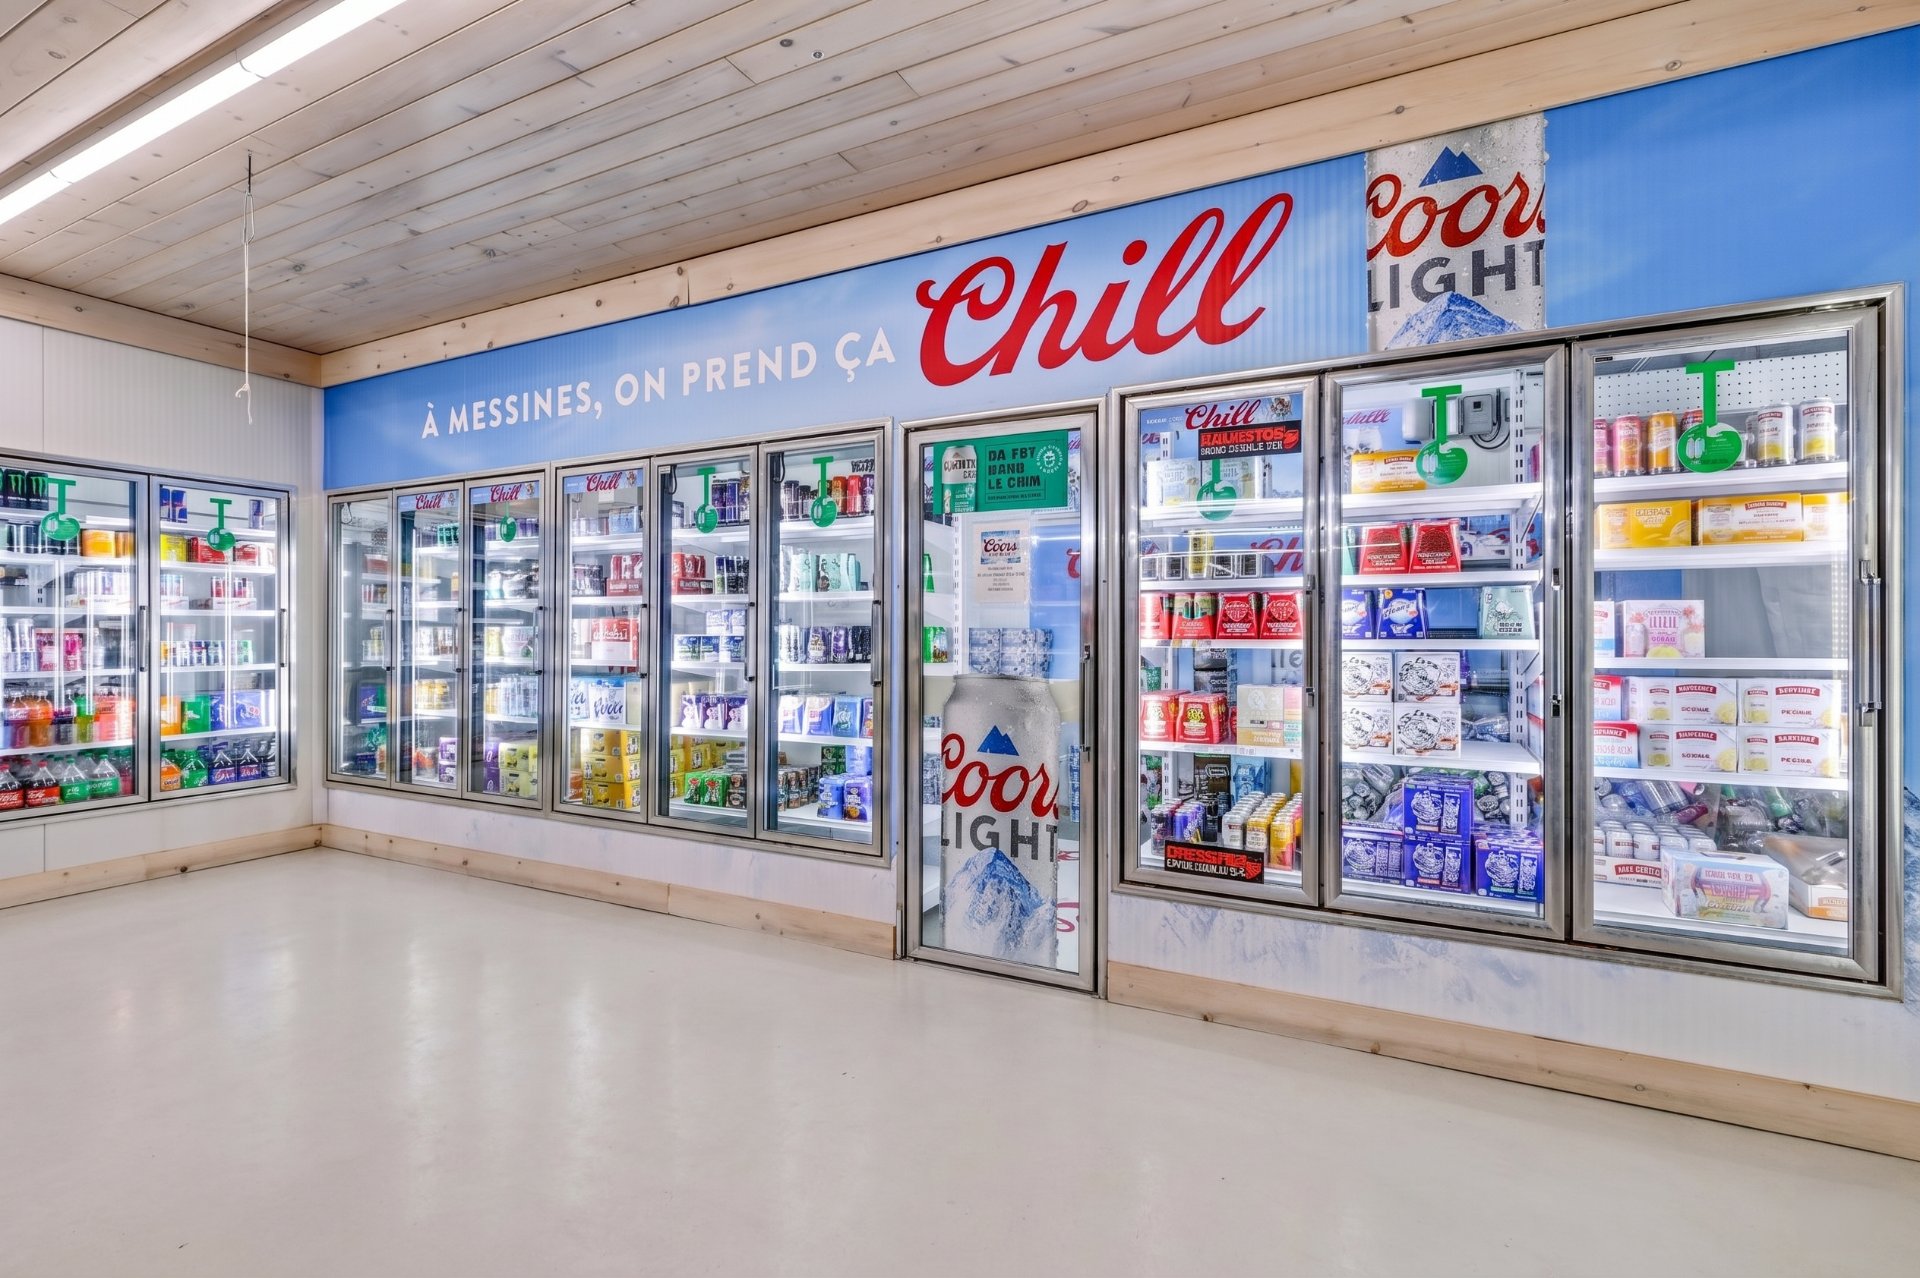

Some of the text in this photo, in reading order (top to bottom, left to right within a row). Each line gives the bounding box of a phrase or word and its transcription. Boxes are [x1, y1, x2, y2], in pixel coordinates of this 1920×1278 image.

[1366, 171, 1546, 262] Coor
[916, 193, 1294, 386] Chill
[421, 326, 896, 439] À MESSINES, ON PREND ÇA
[1185, 399, 1262, 430] Chill
[983, 538, 1017, 552] Coors
[941, 733, 1059, 820] Coor
